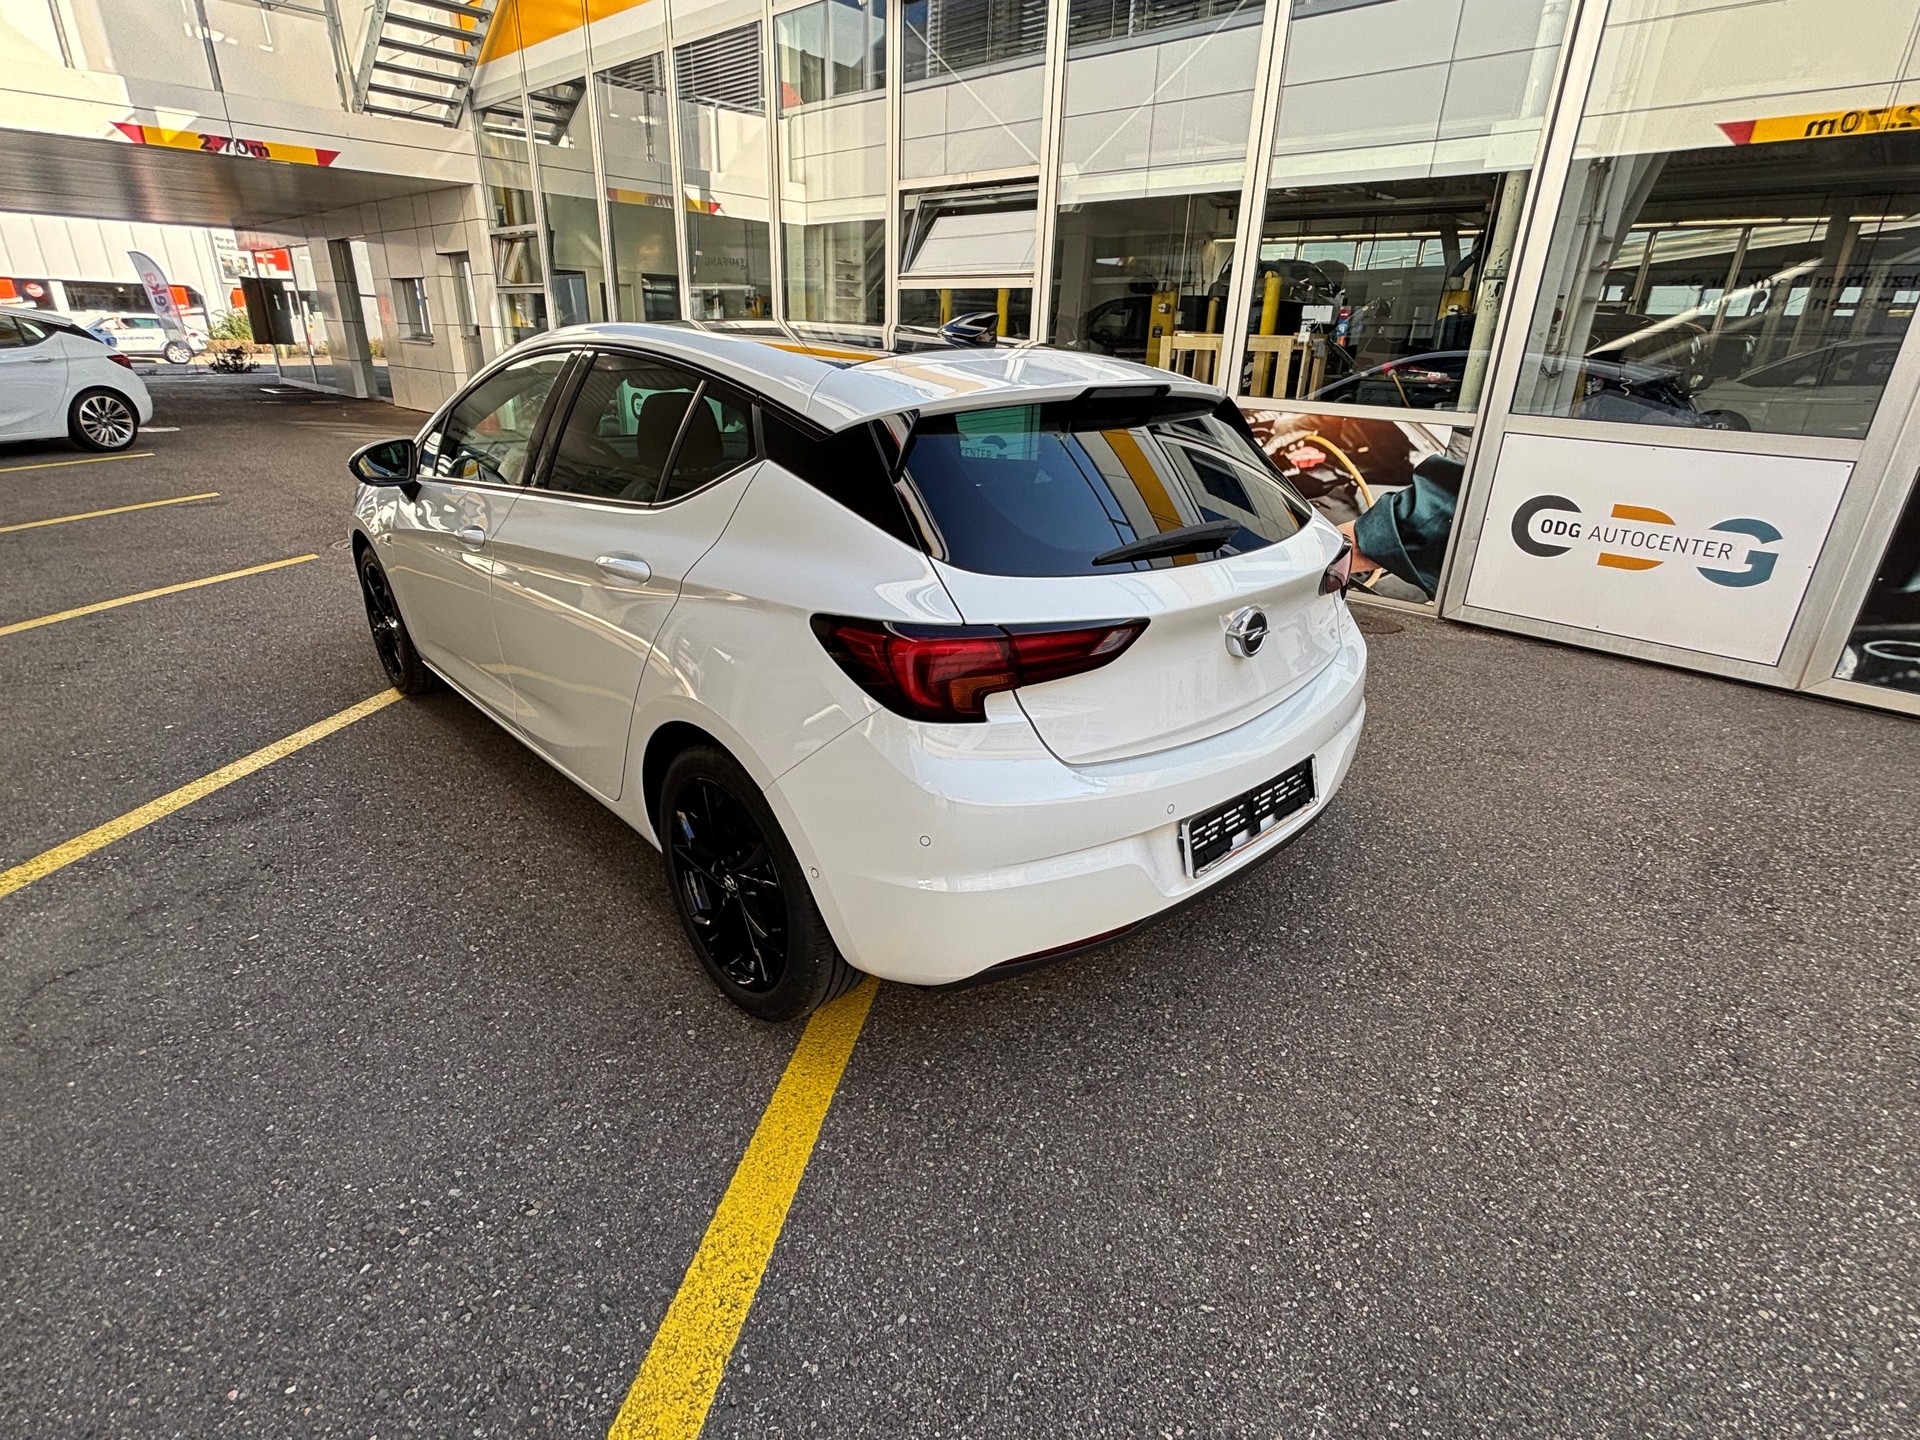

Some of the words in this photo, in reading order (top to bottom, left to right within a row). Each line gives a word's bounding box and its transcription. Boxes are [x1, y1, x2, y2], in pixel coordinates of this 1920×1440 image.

[198, 133, 271, 160] 2.70m
[1540, 518, 1582, 538] ODG
[1588, 525, 1733, 560] AUTOCENTER
